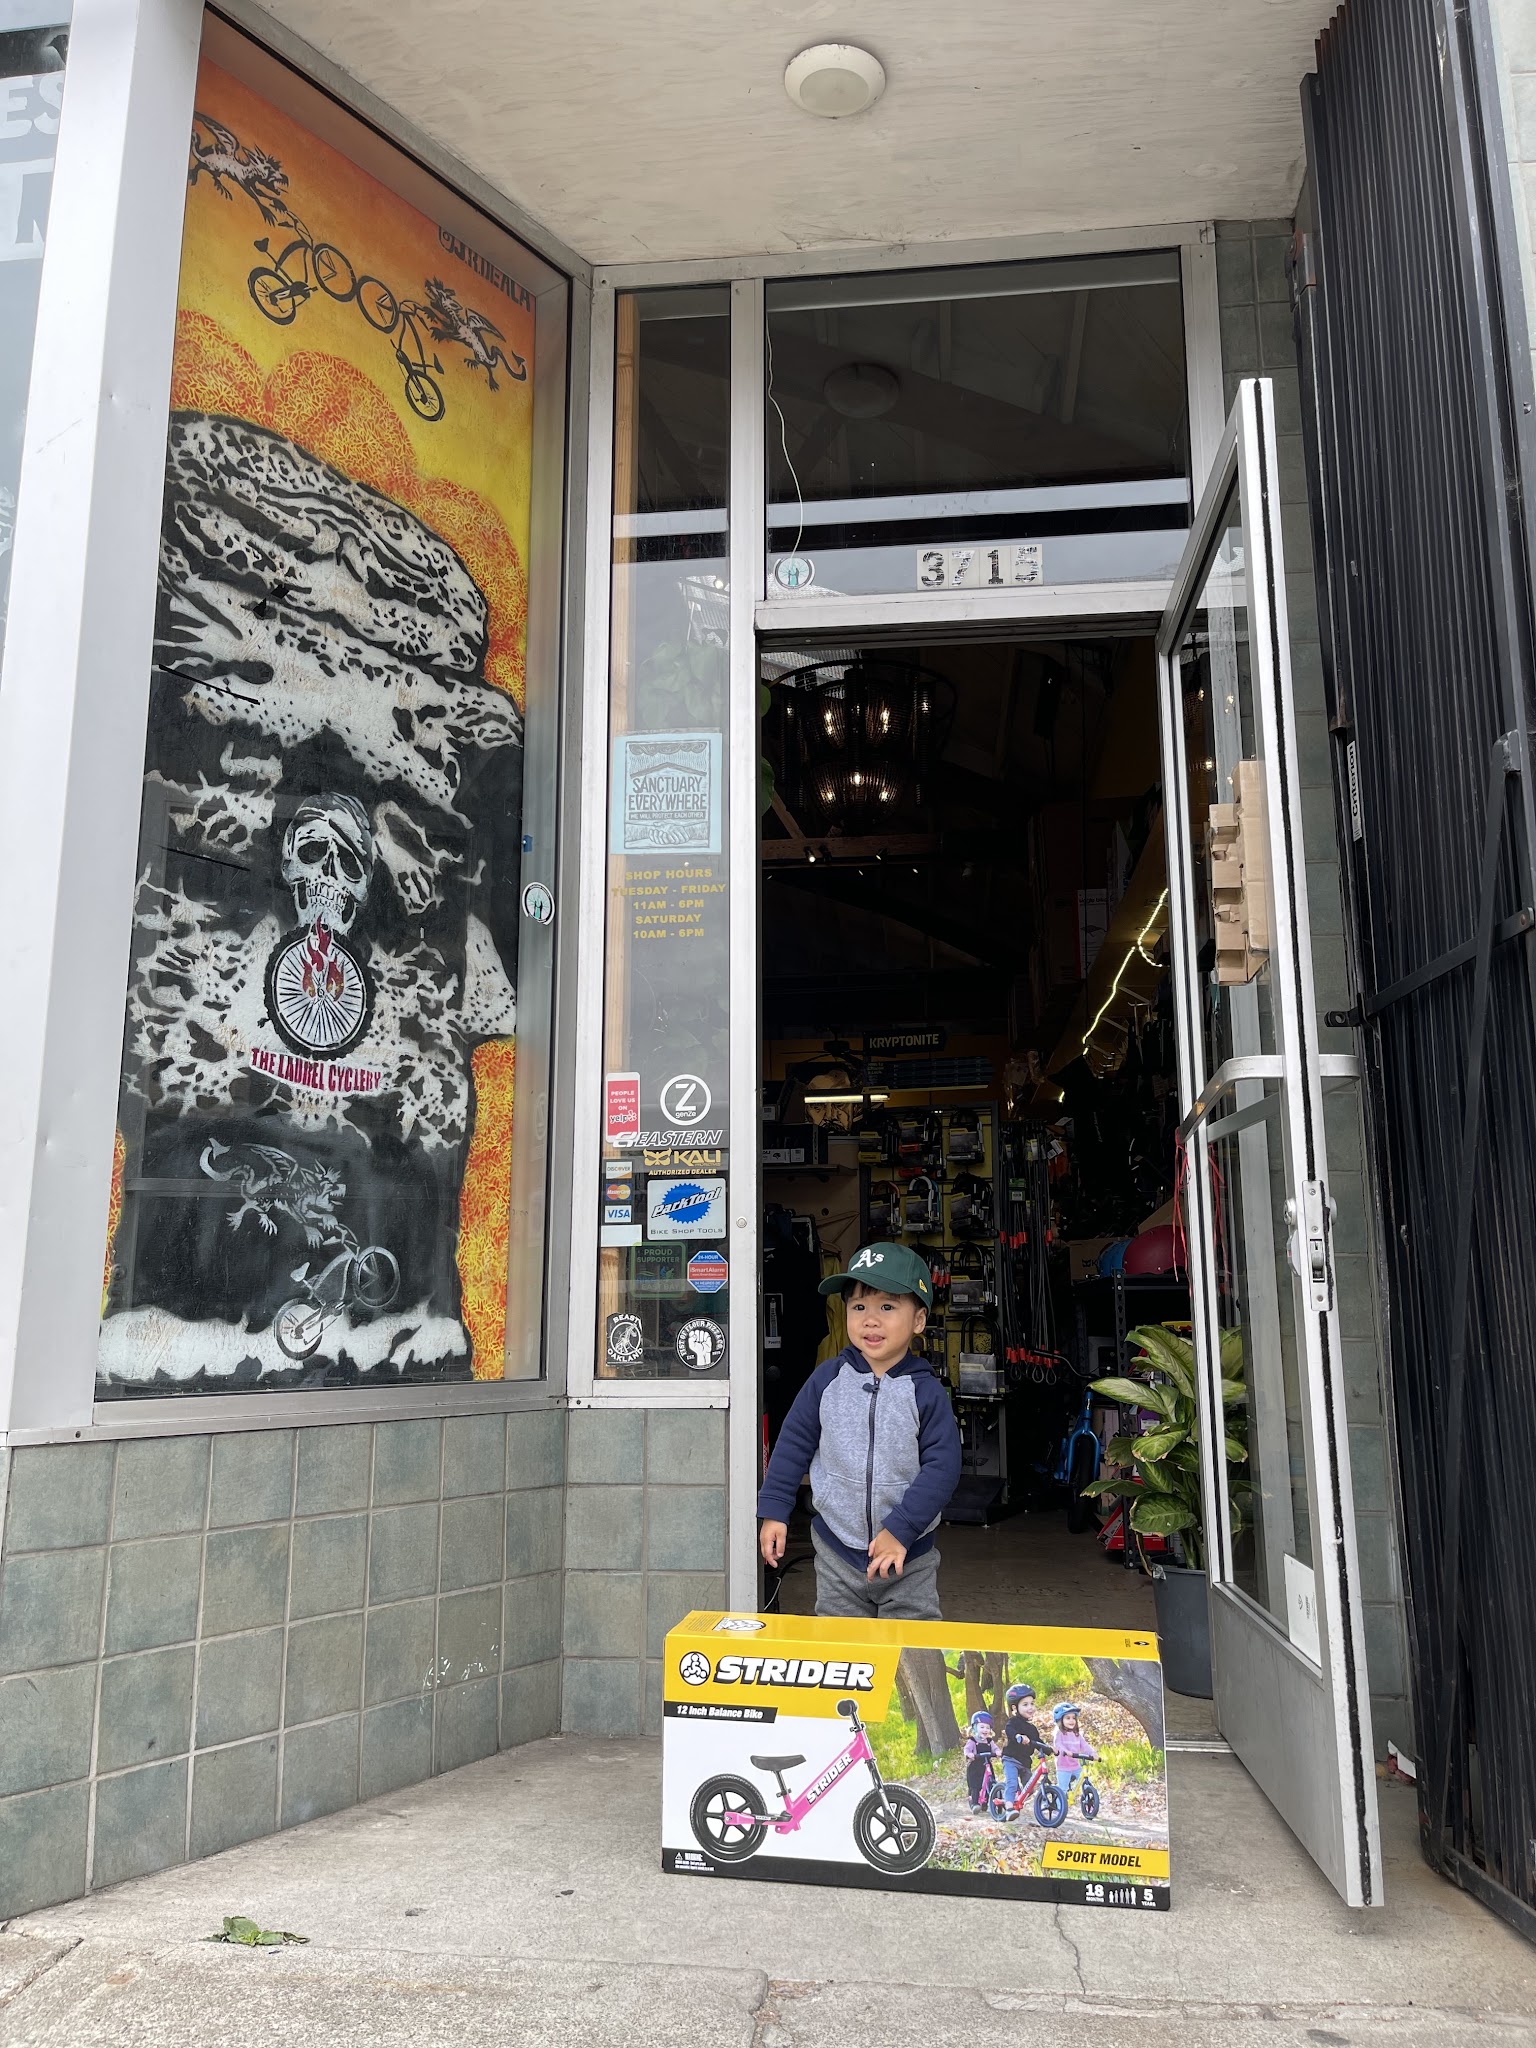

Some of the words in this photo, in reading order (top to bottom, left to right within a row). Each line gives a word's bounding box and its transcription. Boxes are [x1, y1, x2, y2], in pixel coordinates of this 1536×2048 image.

[921, 546, 1038, 587] 3715
[633, 776, 702, 793] SANCTUARY
[1349, 745, 1358, 817] Criterion
[629, 794, 707, 810] EVERYWHERE
[625, 871, 661, 880] SHOP
[666, 869, 713, 879] HOURS
[611, 886, 669, 896] TUESDAY
[681, 884, 726, 894] FRIDAY
[633, 901, 667, 909] 11AM
[679, 899, 704, 908] 6PM
[636, 914, 701, 924] SATURDAY
[633, 930, 667, 939] 10AM
[679, 928, 704, 937] 6PM
[869, 1033, 939, 1048] KRYPTONITE
[252, 1048, 277, 1075] THE
[278, 1054, 324, 1090] LAUREL
[328, 1064, 381, 1092] CYCLERY
[610, 1114, 628, 1124] yelp
[635, 1130, 723, 1146] EASTERN
[674, 1150, 721, 1166] KALI
[607, 1210, 630, 1218] VISA
[851, 1249, 884, 1271] A's
[613, 1314, 641, 1323] BEAST
[685, 1321, 705, 1331] FLOUR
[608, 1348, 643, 1362] OAKLAND
[713, 1655, 874, 1691] STRIDER
[677, 1705, 688, 1714] 12
[689, 1706, 707, 1716] Inch
[709, 1707, 742, 1718] Balance
[744, 1709, 763, 1719] Bike
[807, 1752, 853, 1805] STRIDER
[1057, 1850, 1097, 1863] SPORT
[1100, 1853, 1142, 1867] MODEL
[1086, 1884, 1104, 1897] 18
[1144, 1889, 1153, 1901] 5
